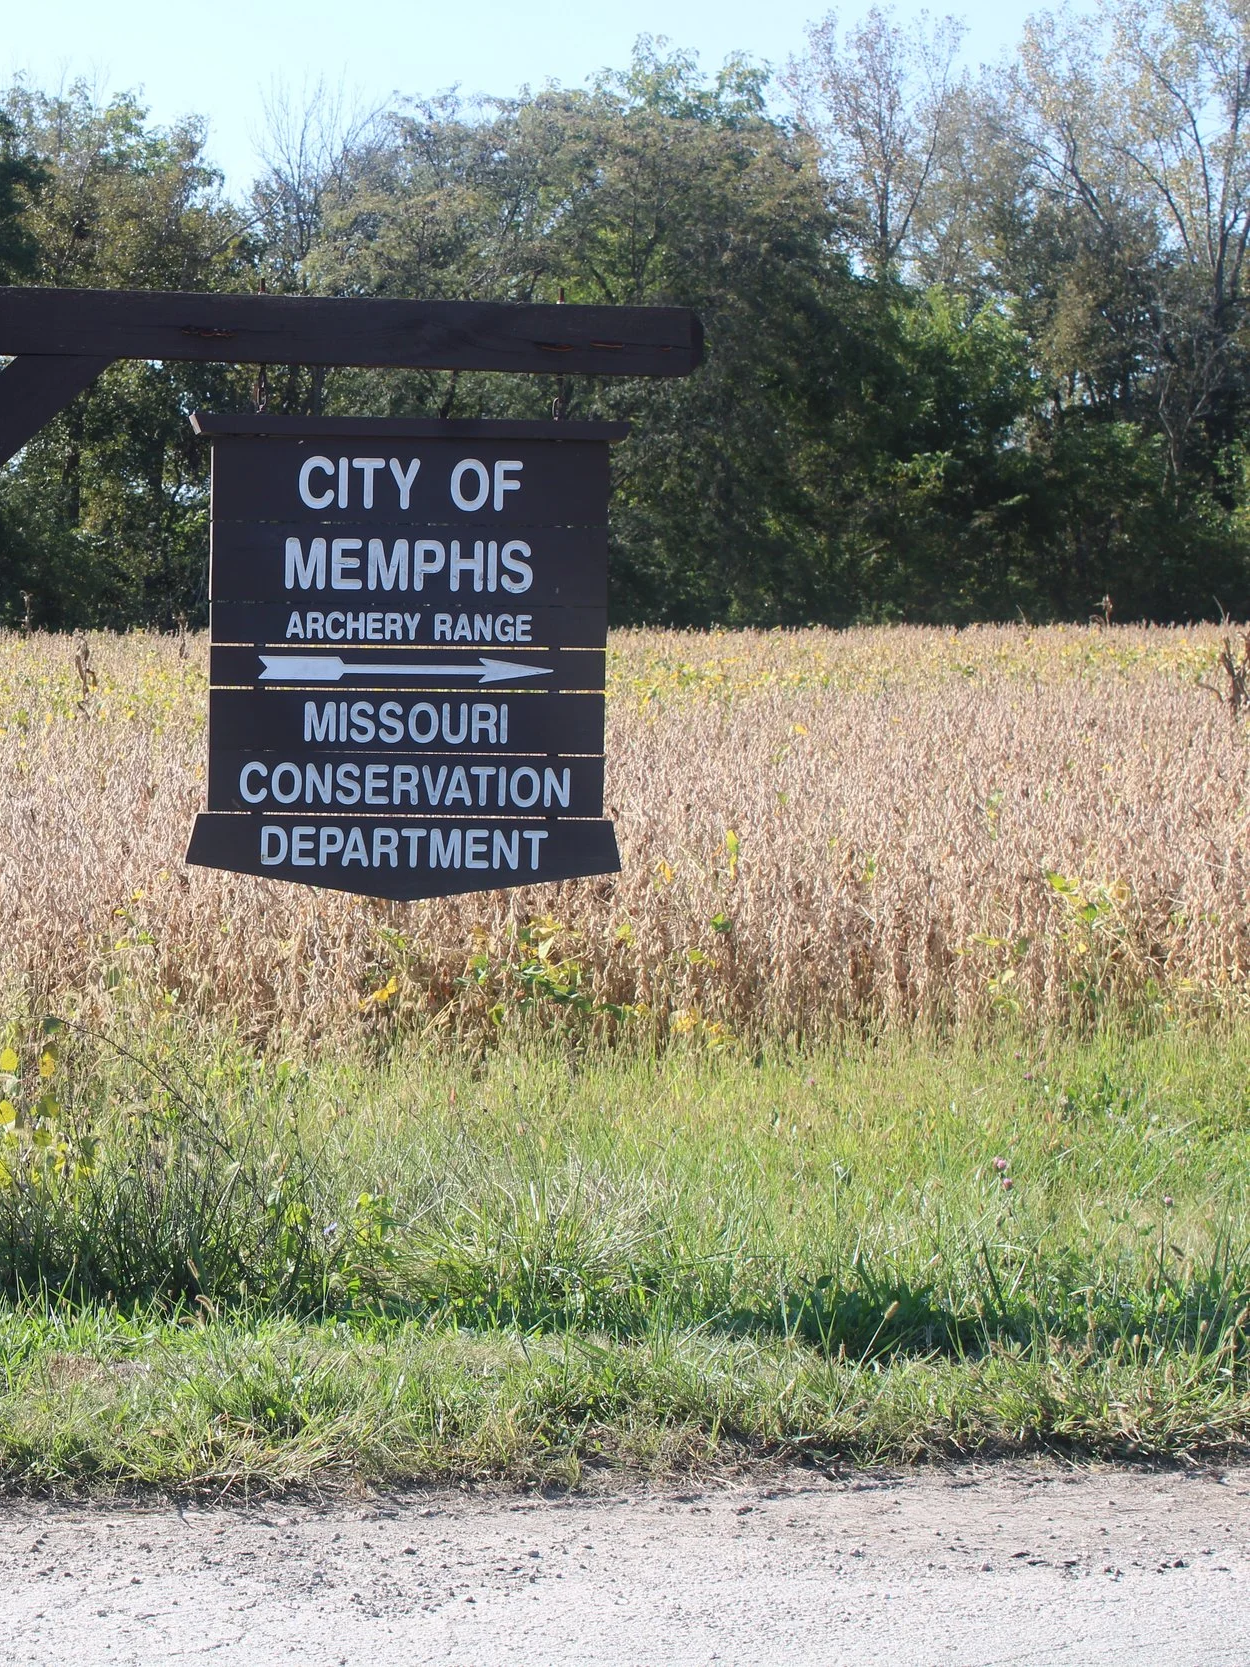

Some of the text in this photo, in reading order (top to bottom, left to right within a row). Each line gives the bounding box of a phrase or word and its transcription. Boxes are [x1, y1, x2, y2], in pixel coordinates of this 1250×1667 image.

[298, 455, 524, 512] CITY OF
[284, 537, 533, 594] MEMPHIS
[285, 611, 533, 642] ARCHERY RANGE
[304, 701, 508, 744] MISSOURI
[239, 761, 571, 808] CONSERVATION
[260, 825, 549, 871] DEPARTMENT
